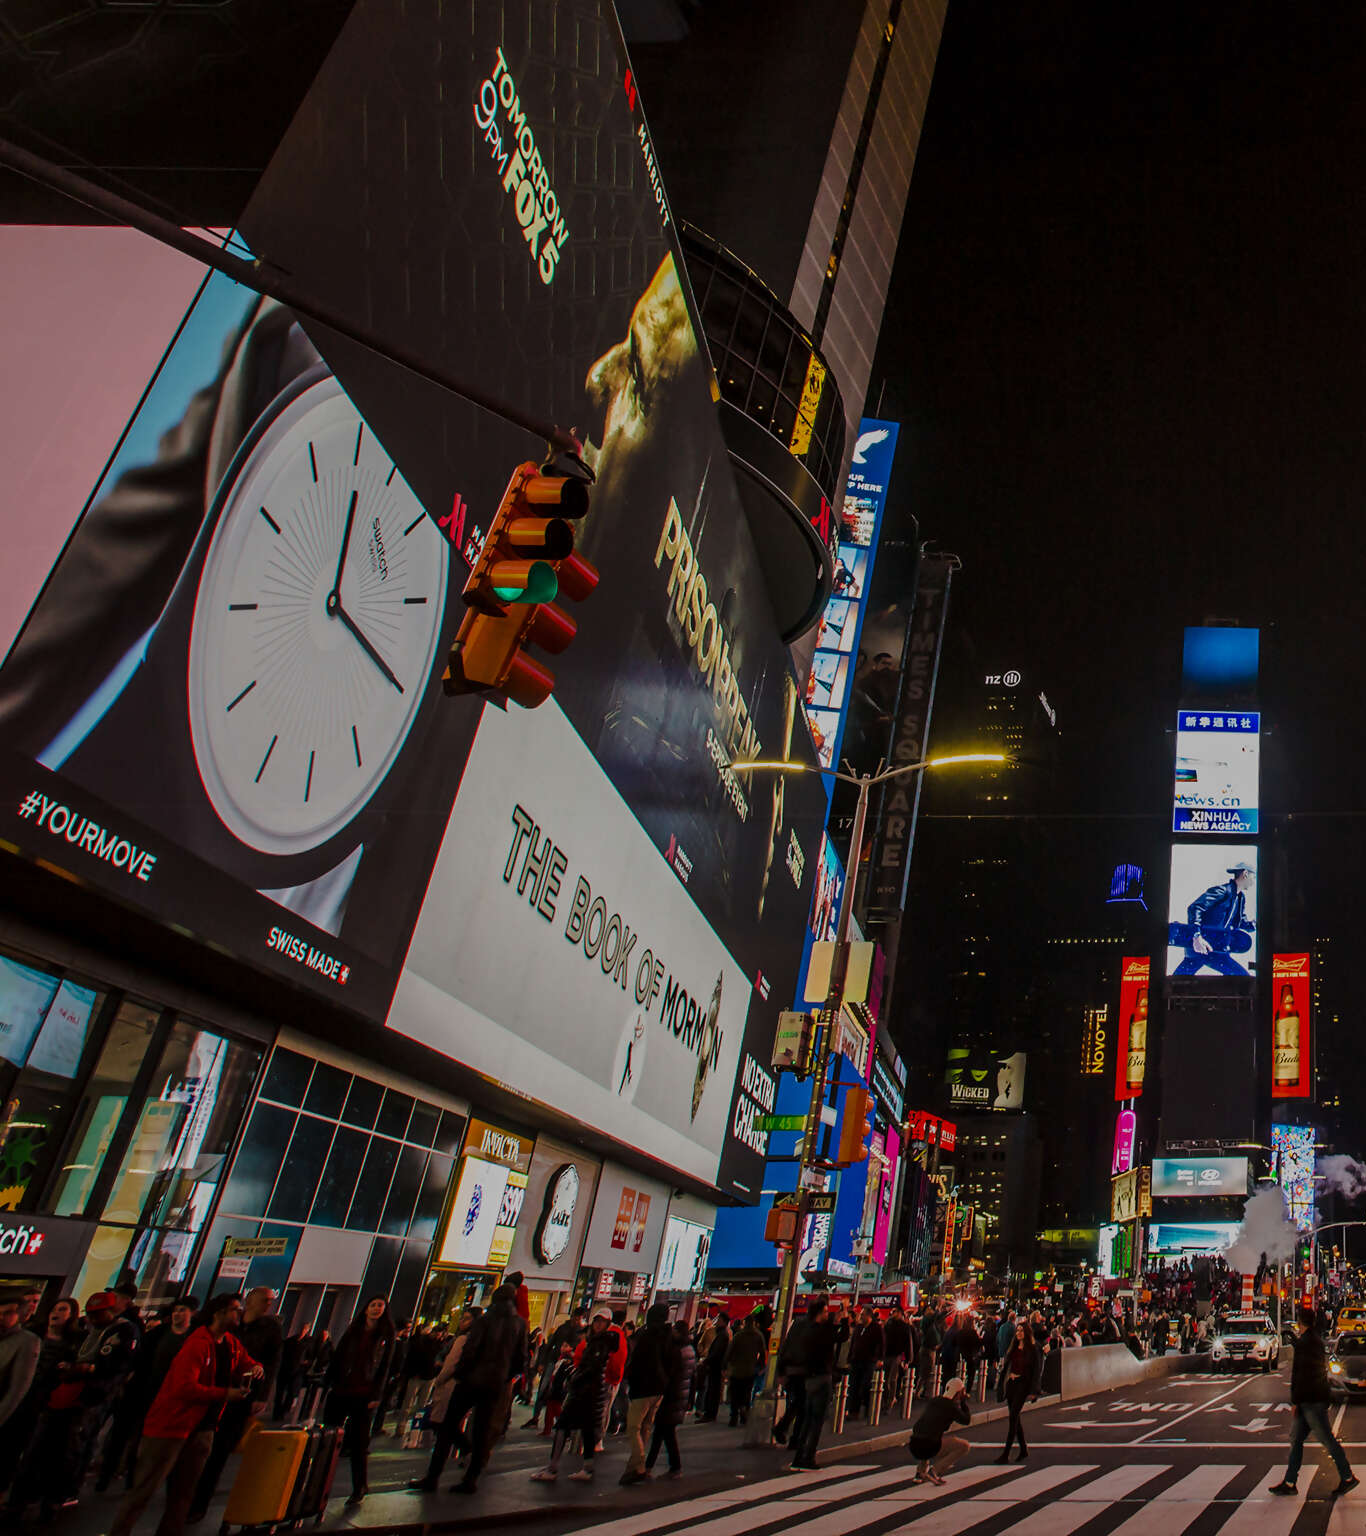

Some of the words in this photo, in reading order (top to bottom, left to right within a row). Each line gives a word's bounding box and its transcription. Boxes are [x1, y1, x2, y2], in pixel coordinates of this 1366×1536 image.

[473, 78, 509, 176] 9PM
[502, 148, 549, 261] FOX
[538, 237, 561, 285] 5
[492, 46, 570, 248] TOMORROW
[637, 123, 670, 228] MARRIOTT
[857, 484, 883, 493] HERE
[907, 588, 942, 699] TIMES
[880, 714, 921, 868] SQUARE
[1180, 821, 1207, 831] NEWS
[1207, 821, 1251, 832] AGENCY
[1191, 810, 1241, 822] XINHUA
[18, 789, 158, 882] #YOURMOVE
[502, 803, 569, 923] THE
[564, 874, 638, 991] BOOK
[633, 947, 665, 1012] OF
[265, 926, 308, 963] SWISS
[305, 945, 343, 980] MADE
[1092, 1002, 1109, 1074] NOVOTEL
[741, 1052, 757, 1094] NO
[755, 1063, 777, 1115] EXTRA
[479, 1128, 521, 1163] INVICTA
[809, 1197, 828, 1209] WAY
